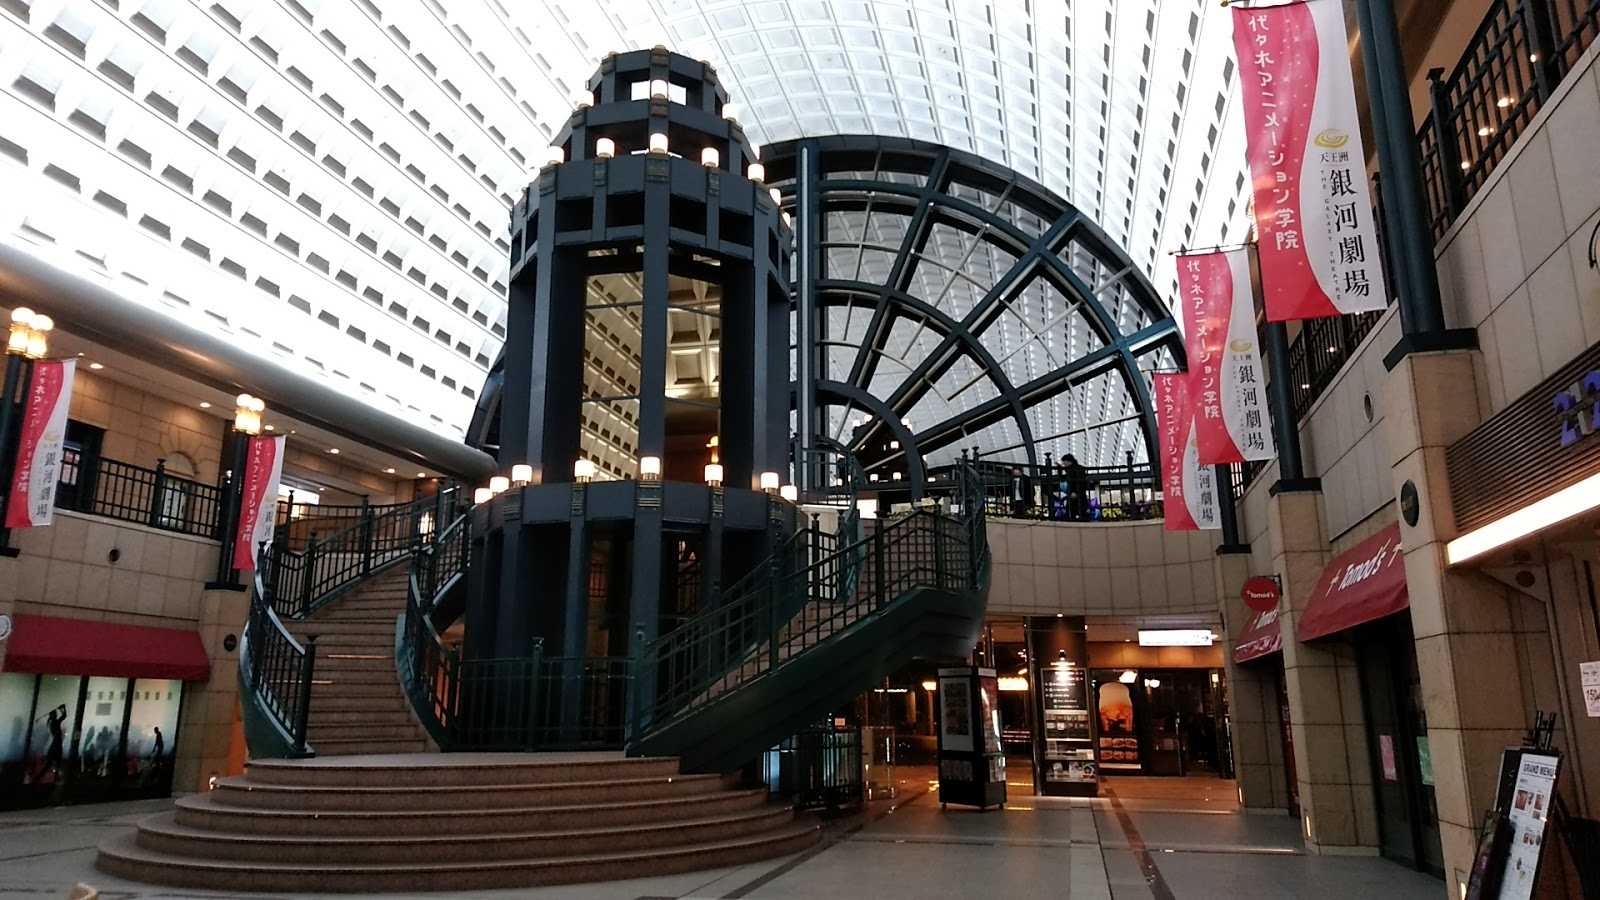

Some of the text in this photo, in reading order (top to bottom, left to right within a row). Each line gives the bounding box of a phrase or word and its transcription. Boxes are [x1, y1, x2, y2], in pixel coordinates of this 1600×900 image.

[1249, 15, 1299, 250] 代々木アニメーション学院
[1320, 151, 1349, 162] 天王洲
[1330, 168, 1370, 297] 銀河劇場
[1187, 260, 1220, 419] 代々木アニメーション学院
[1238, 365, 1264, 451] 銀河劇場
[1338, 537, 1391, 591] Tomod's
